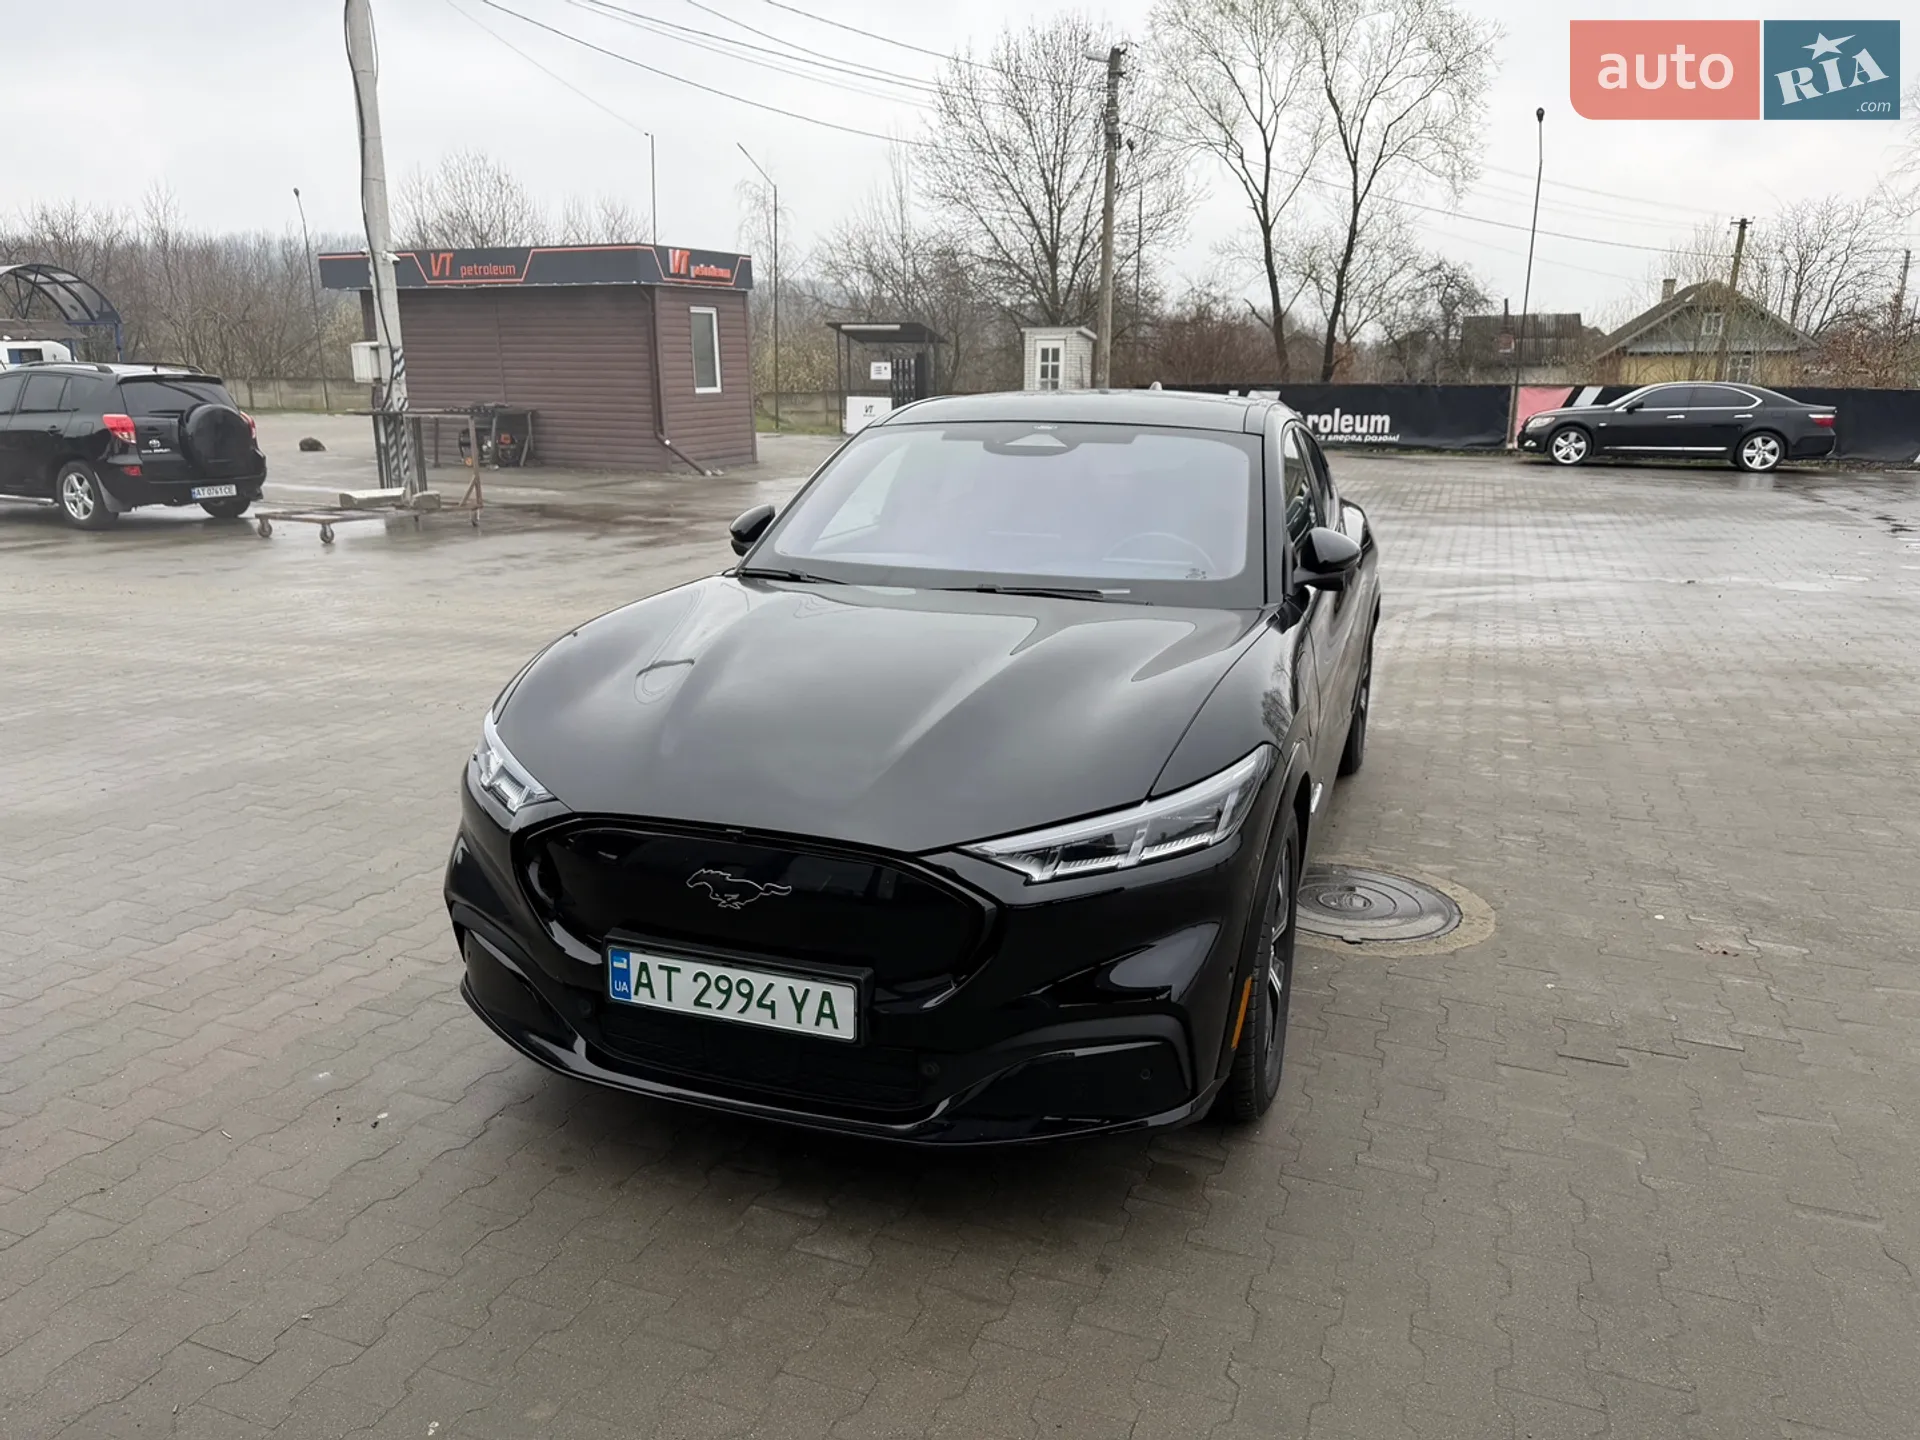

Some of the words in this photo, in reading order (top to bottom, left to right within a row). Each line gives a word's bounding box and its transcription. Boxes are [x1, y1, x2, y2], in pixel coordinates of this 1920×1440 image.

[430, 252, 454, 277] VT
[460, 263, 516, 278] petroleum
[614, 979, 629, 994] UA
[633, 961, 681, 1002] AT
[692, 970, 776, 1020] 2994
[788, 985, 839, 1030] YA
